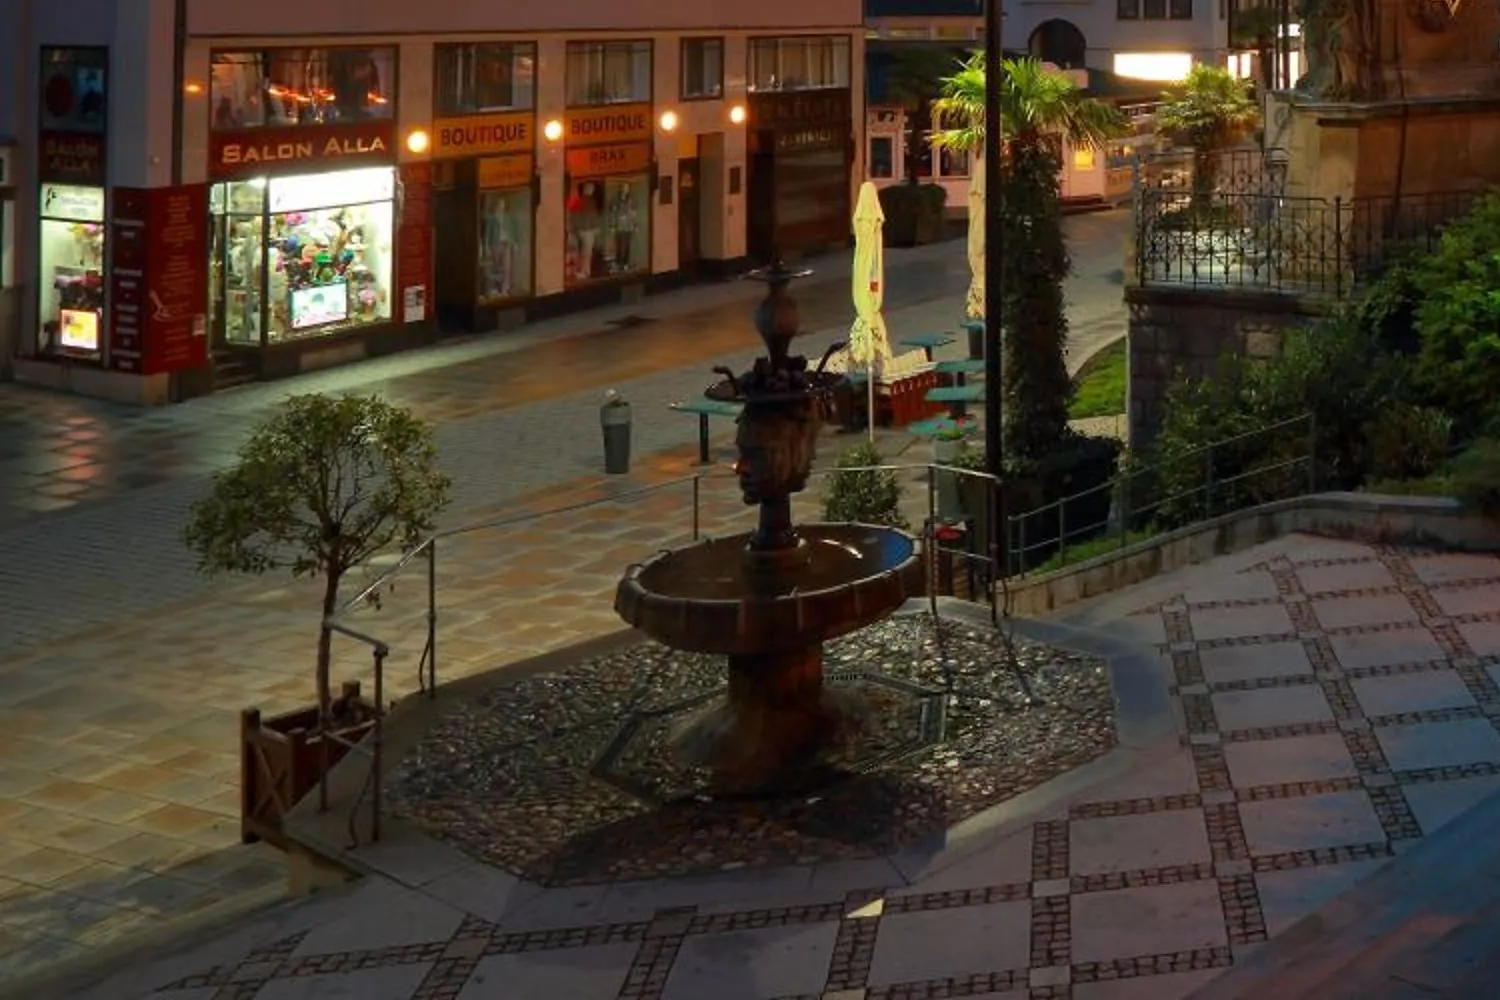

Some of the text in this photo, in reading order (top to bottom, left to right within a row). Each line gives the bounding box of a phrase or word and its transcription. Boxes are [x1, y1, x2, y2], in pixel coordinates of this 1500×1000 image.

[440, 122, 528, 147] BOUTIQUE
[570, 114, 646, 136] BOUTIQUE
[222, 135, 386, 164] SALON ALLA
